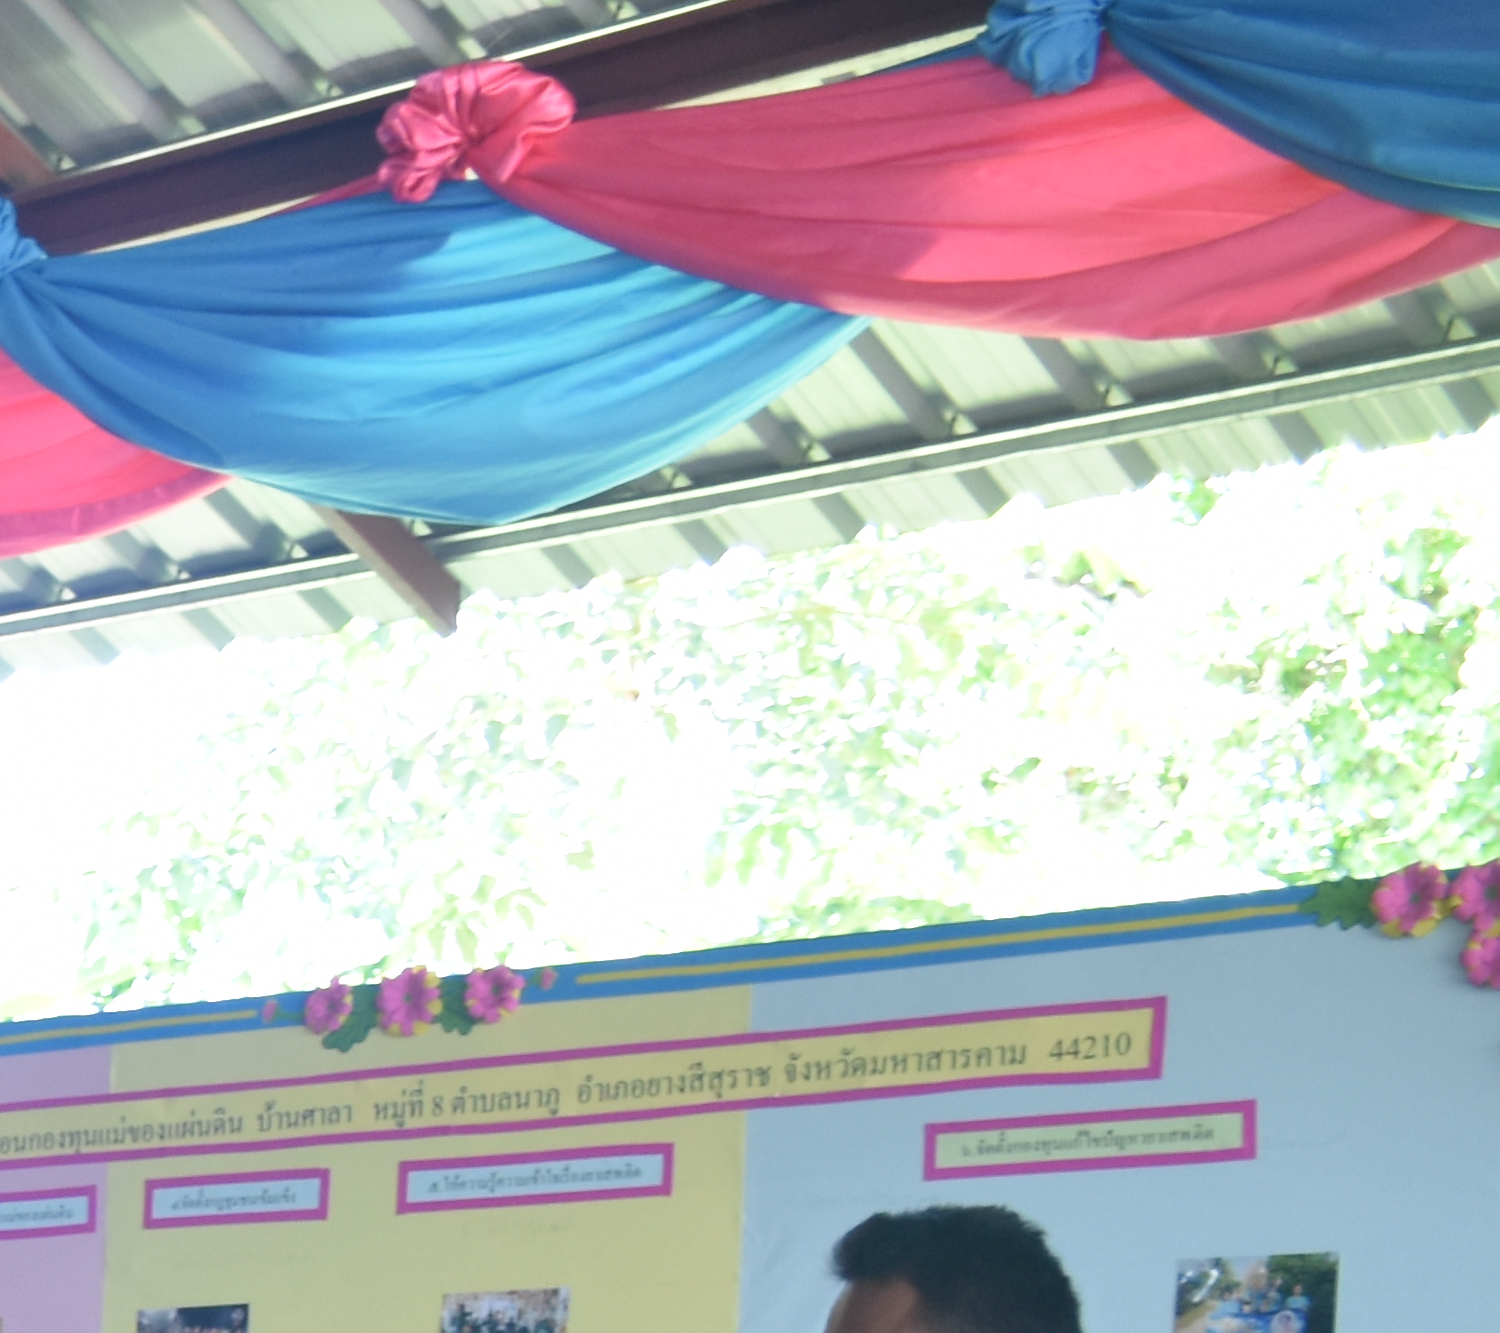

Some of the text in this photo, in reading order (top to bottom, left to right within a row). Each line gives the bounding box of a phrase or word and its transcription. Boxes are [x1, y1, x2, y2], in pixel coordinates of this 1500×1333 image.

[256, 1098, 354, 1134] บ้านศาลา
[577, 1060, 772, 1105] อำเภอยางสีสุราช
[785, 1041, 1027, 1084] จังหวัดมหาสารคาม
[1048, 1031, 1133, 1061] 44210
